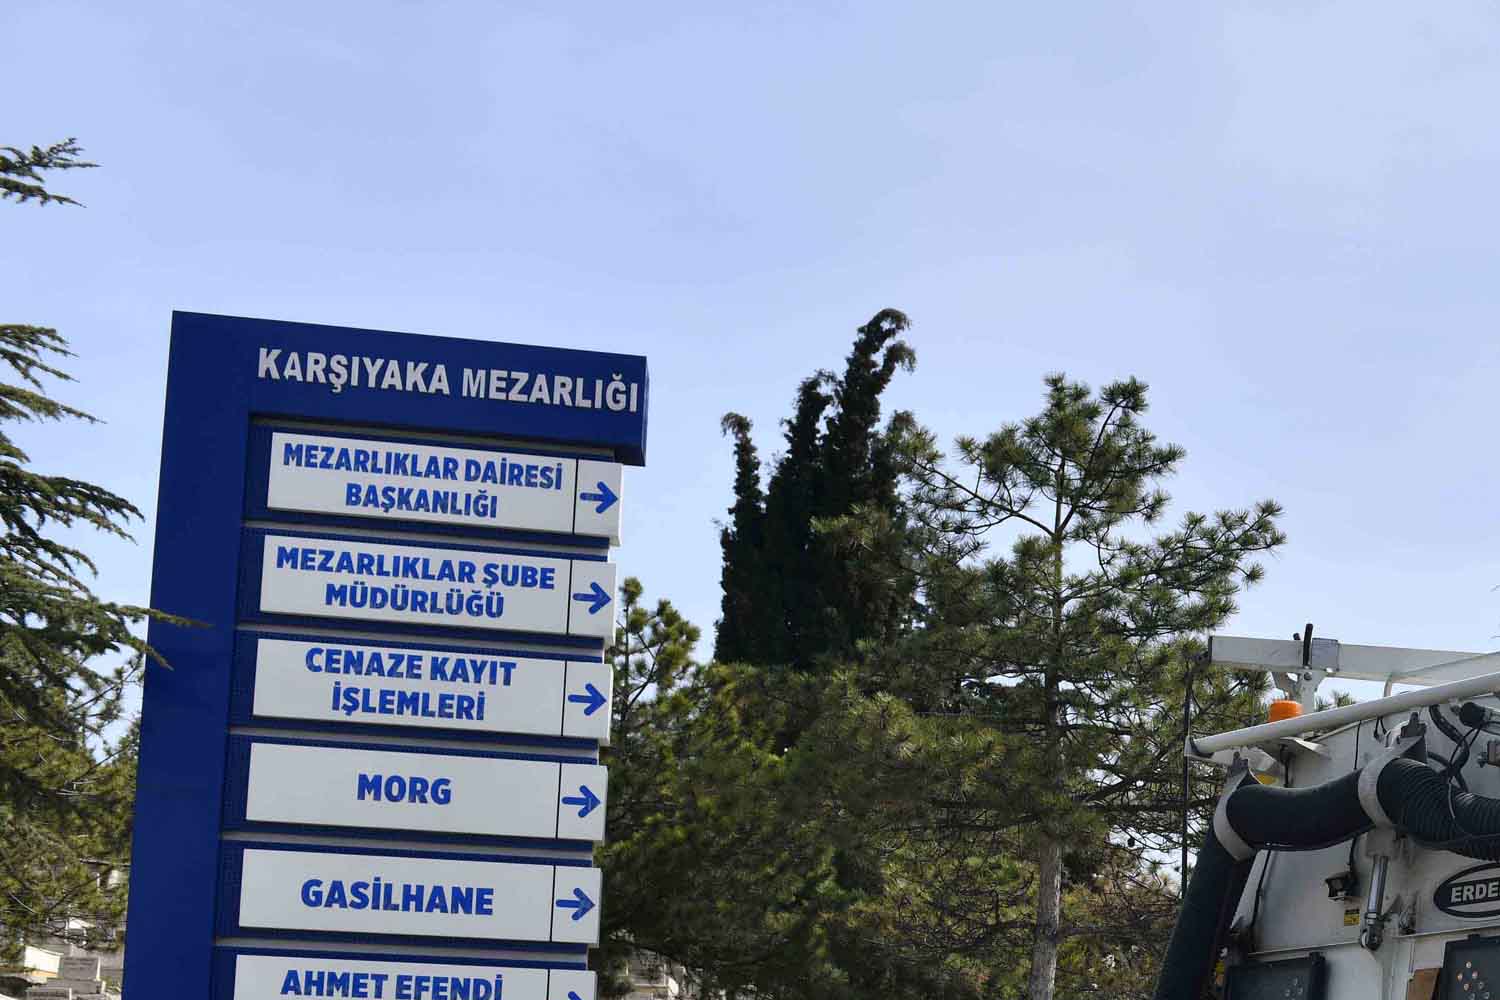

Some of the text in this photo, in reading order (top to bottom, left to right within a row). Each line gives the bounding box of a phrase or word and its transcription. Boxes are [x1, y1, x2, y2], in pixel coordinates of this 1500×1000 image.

[257, 347, 639, 413] KARŞIYAKA MEZARLIĞI
[283, 443, 563, 490] MEZARLIKLAR DAİRESİ
[345, 483, 498, 518] BAŞKANLIĞI
[277, 546, 556, 589] MEZARLIKLAR ŞUBE
[325, 584, 504, 618] MÜDÜRLÜĞÜ
[305, 647, 516, 686] CENAZE KAYIT
[332, 686, 486, 721] İŞLEMLERİ
[357, 774, 452, 805] MORG
[300, 877, 494, 916] GASİLHANE
[281, 969, 388, 1000] AHMET
